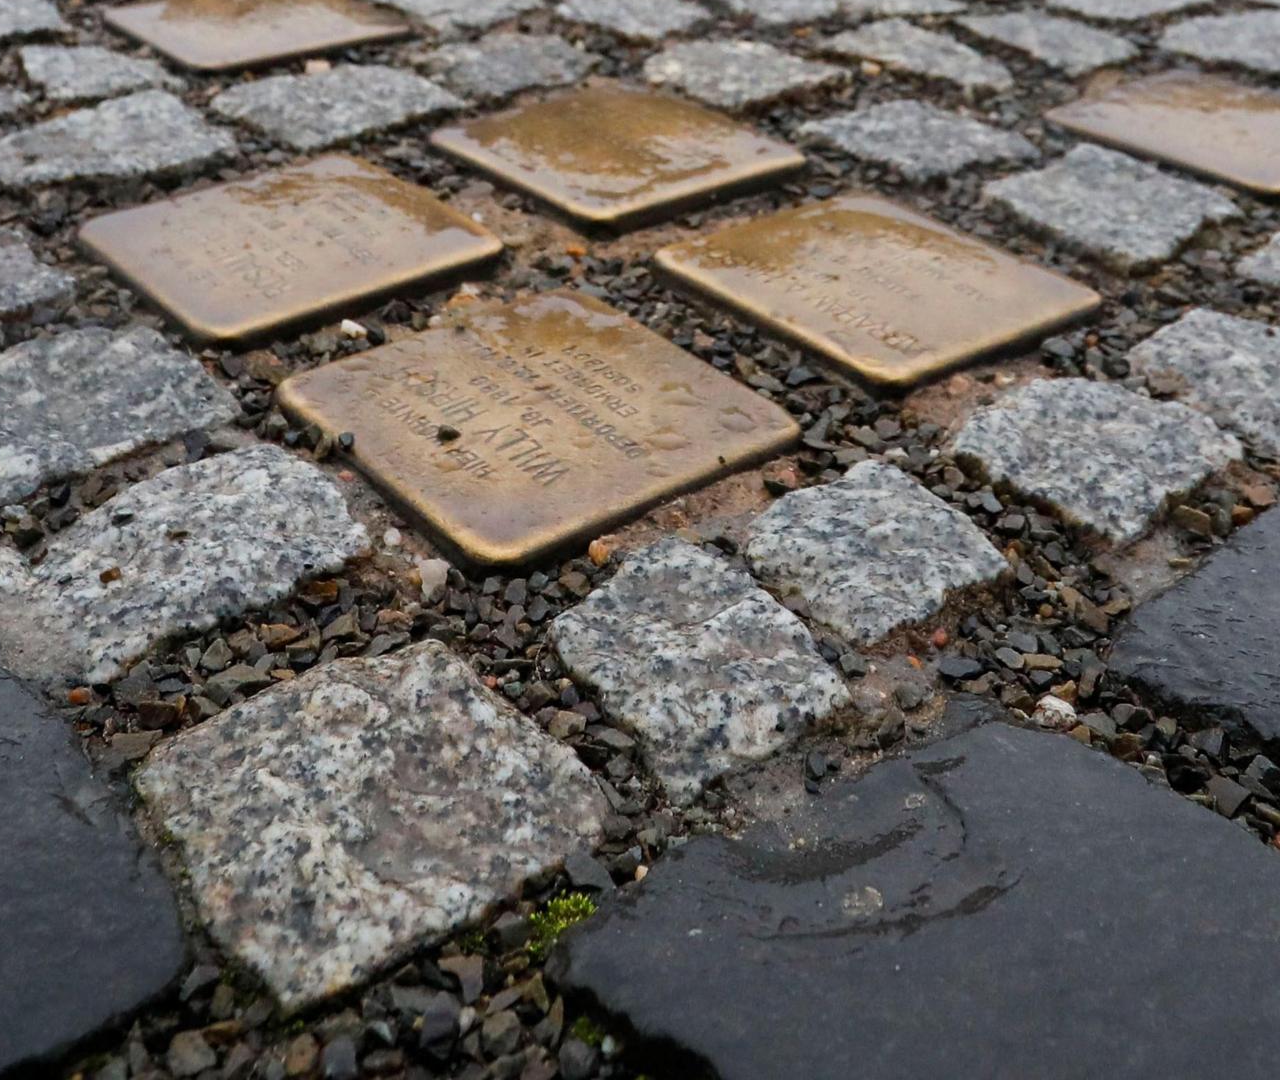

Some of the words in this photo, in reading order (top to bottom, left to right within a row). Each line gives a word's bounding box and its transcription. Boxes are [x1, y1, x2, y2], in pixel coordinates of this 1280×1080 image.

[540, 356, 642, 419] ERMORDET
[441, 444, 500, 480] HIER
[468, 419, 580, 486] WILLY
